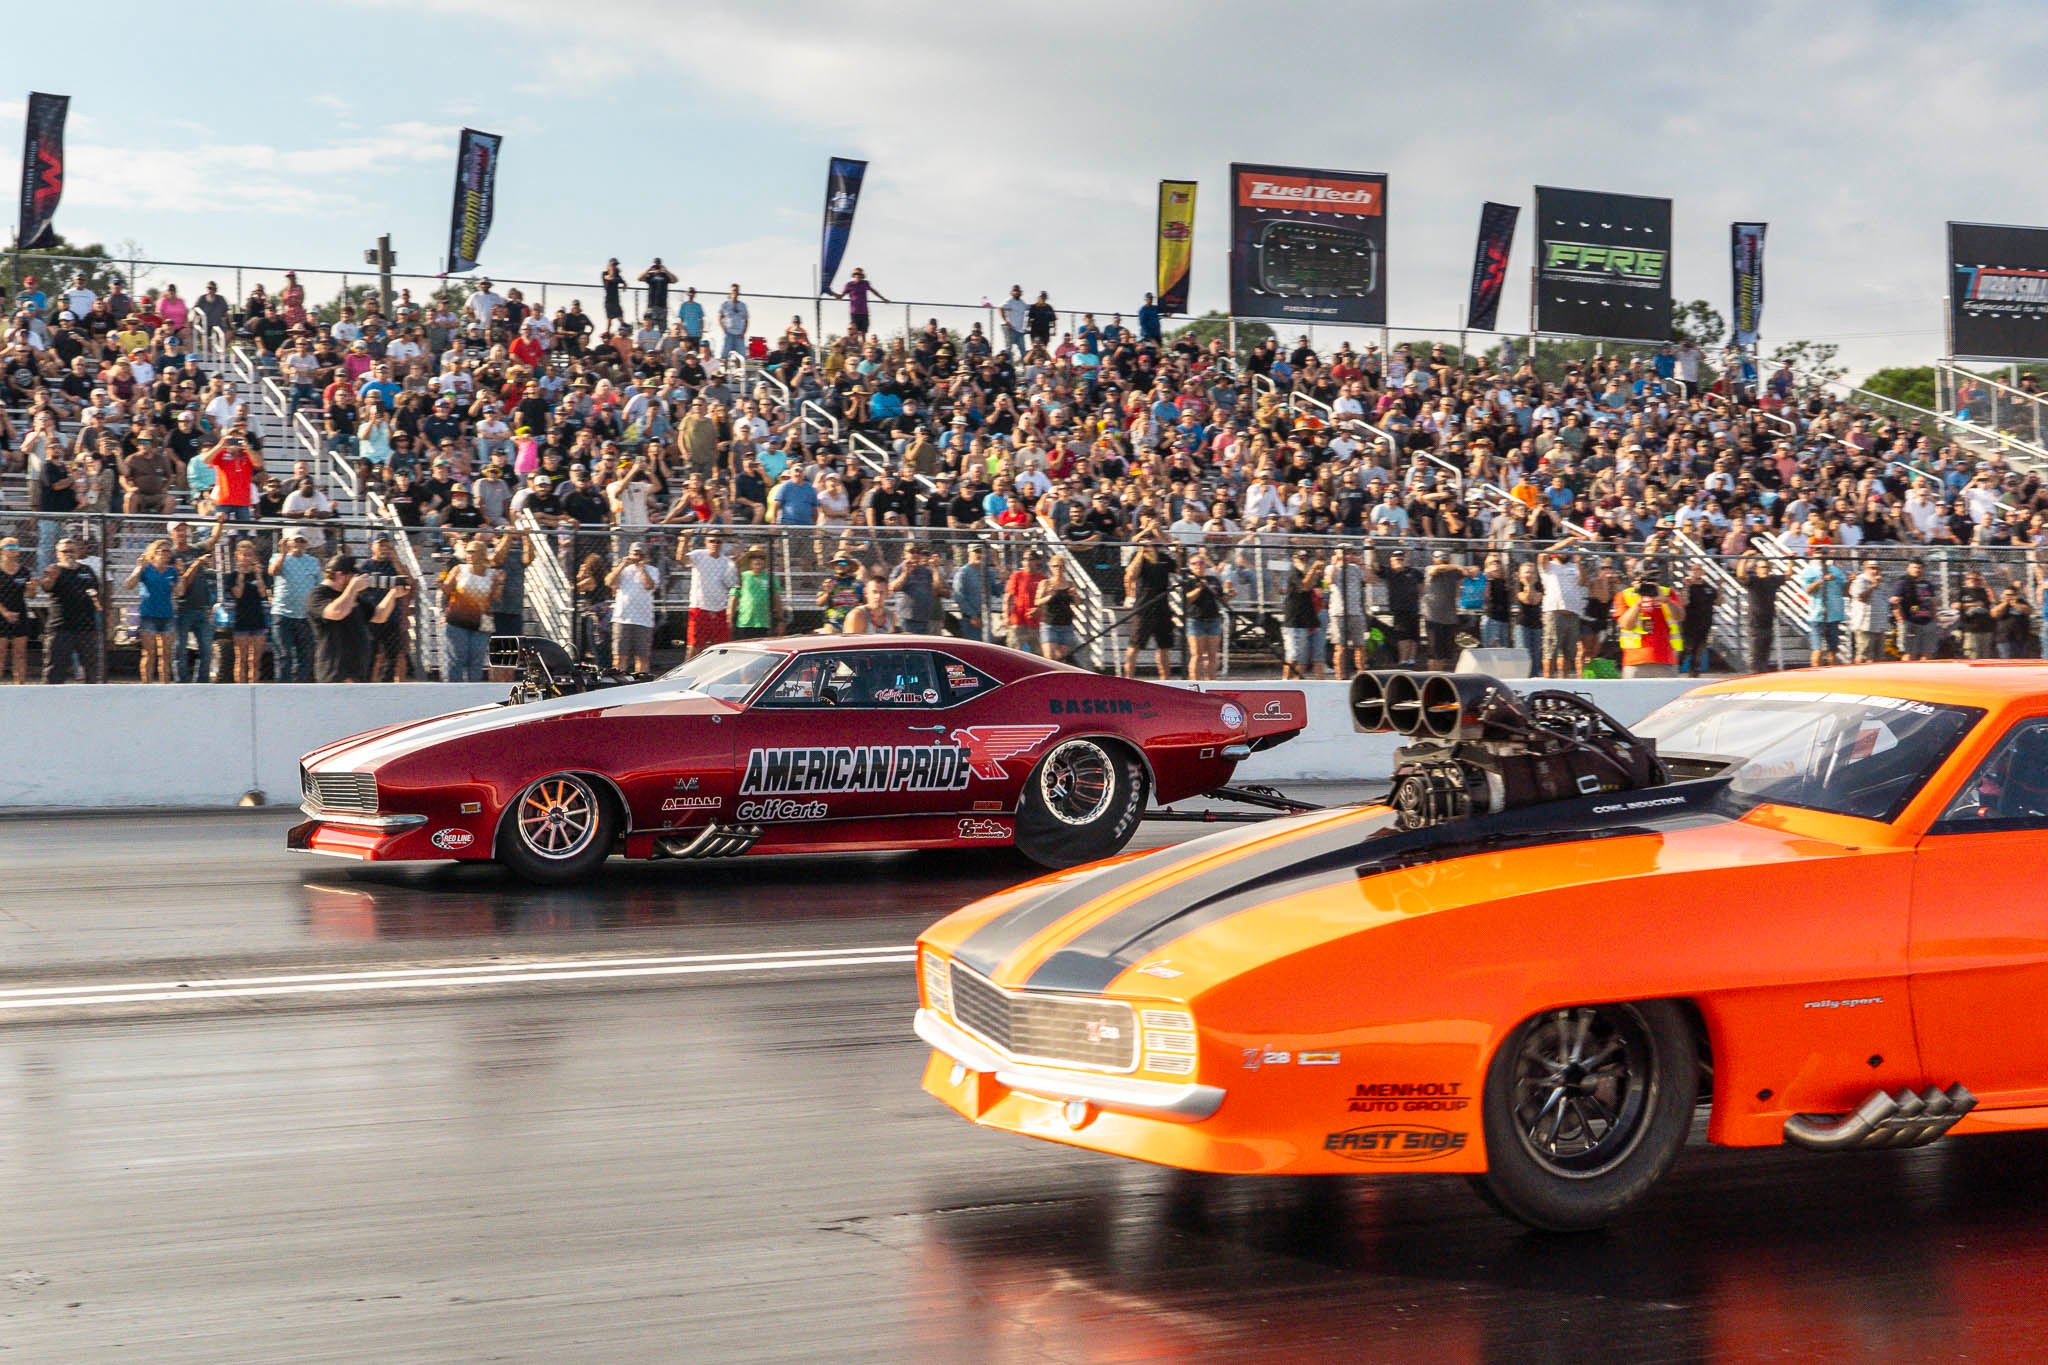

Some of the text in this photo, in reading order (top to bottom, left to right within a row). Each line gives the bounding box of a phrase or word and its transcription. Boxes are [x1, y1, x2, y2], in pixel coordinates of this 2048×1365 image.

[1251, 181, 1373, 204] FuelTech
[1546, 244, 1664, 276] FFRE
[1049, 699, 1133, 715] BASKIN
[739, 746, 972, 795] AMERICAN PRIDE
[736, 799, 828, 820] Golf Carts
[1625, 796, 1687, 810] INDUCTION
[457, 834, 472, 842] LINE
[1355, 1083, 1462, 1096] MENHOLT
[1347, 1100, 1469, 1112] AUTO GROUP
[1324, 1132, 1469, 1150] EAST SIDE
